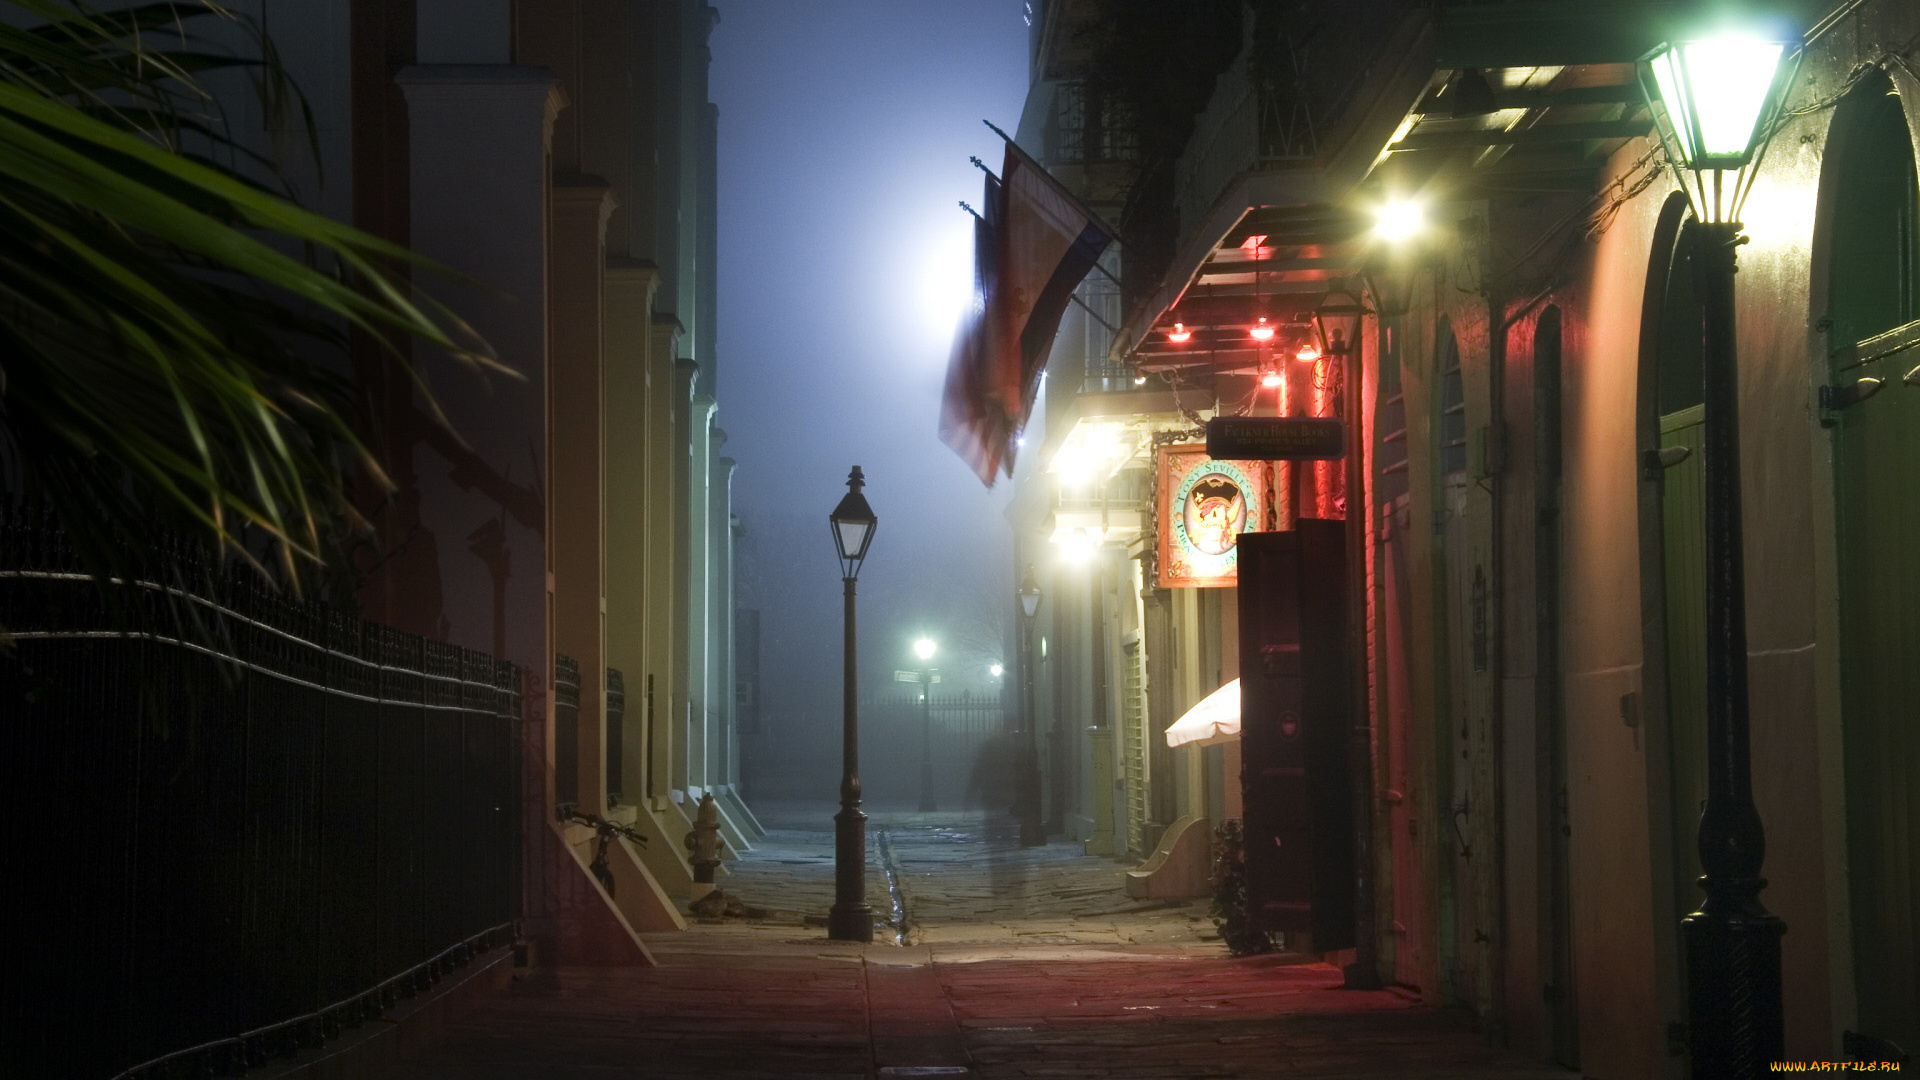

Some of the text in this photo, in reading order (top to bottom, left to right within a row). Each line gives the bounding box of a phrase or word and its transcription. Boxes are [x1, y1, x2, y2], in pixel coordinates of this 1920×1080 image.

[1301, 424, 1330, 438] BOOKS
[1177, 463, 1251, 502] TONY SEVILLE'S
